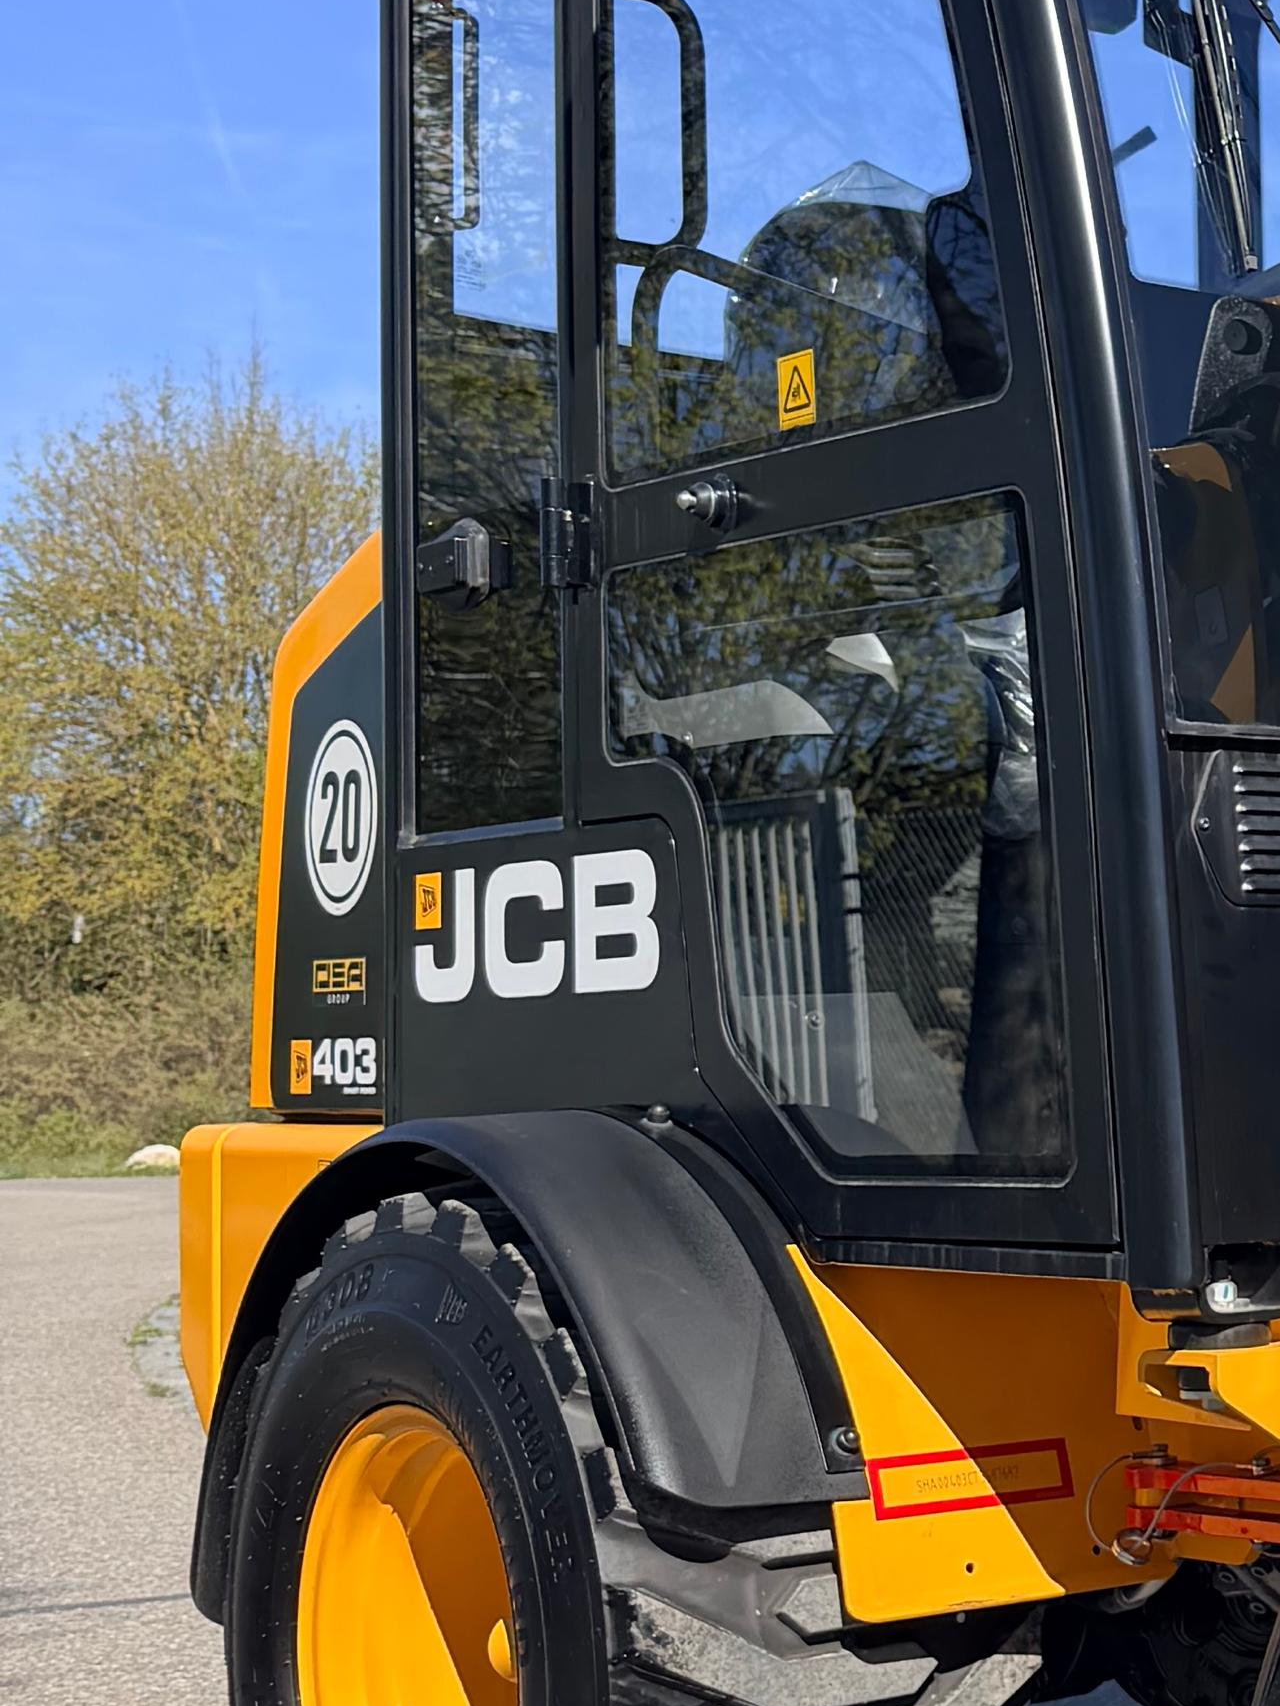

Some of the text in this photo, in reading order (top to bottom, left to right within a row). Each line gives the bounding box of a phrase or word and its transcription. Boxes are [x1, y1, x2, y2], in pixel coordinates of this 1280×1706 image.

[319, 769, 362, 863] 20
[415, 849, 660, 1003] JCB
[312, 1037, 377, 1085] 403
